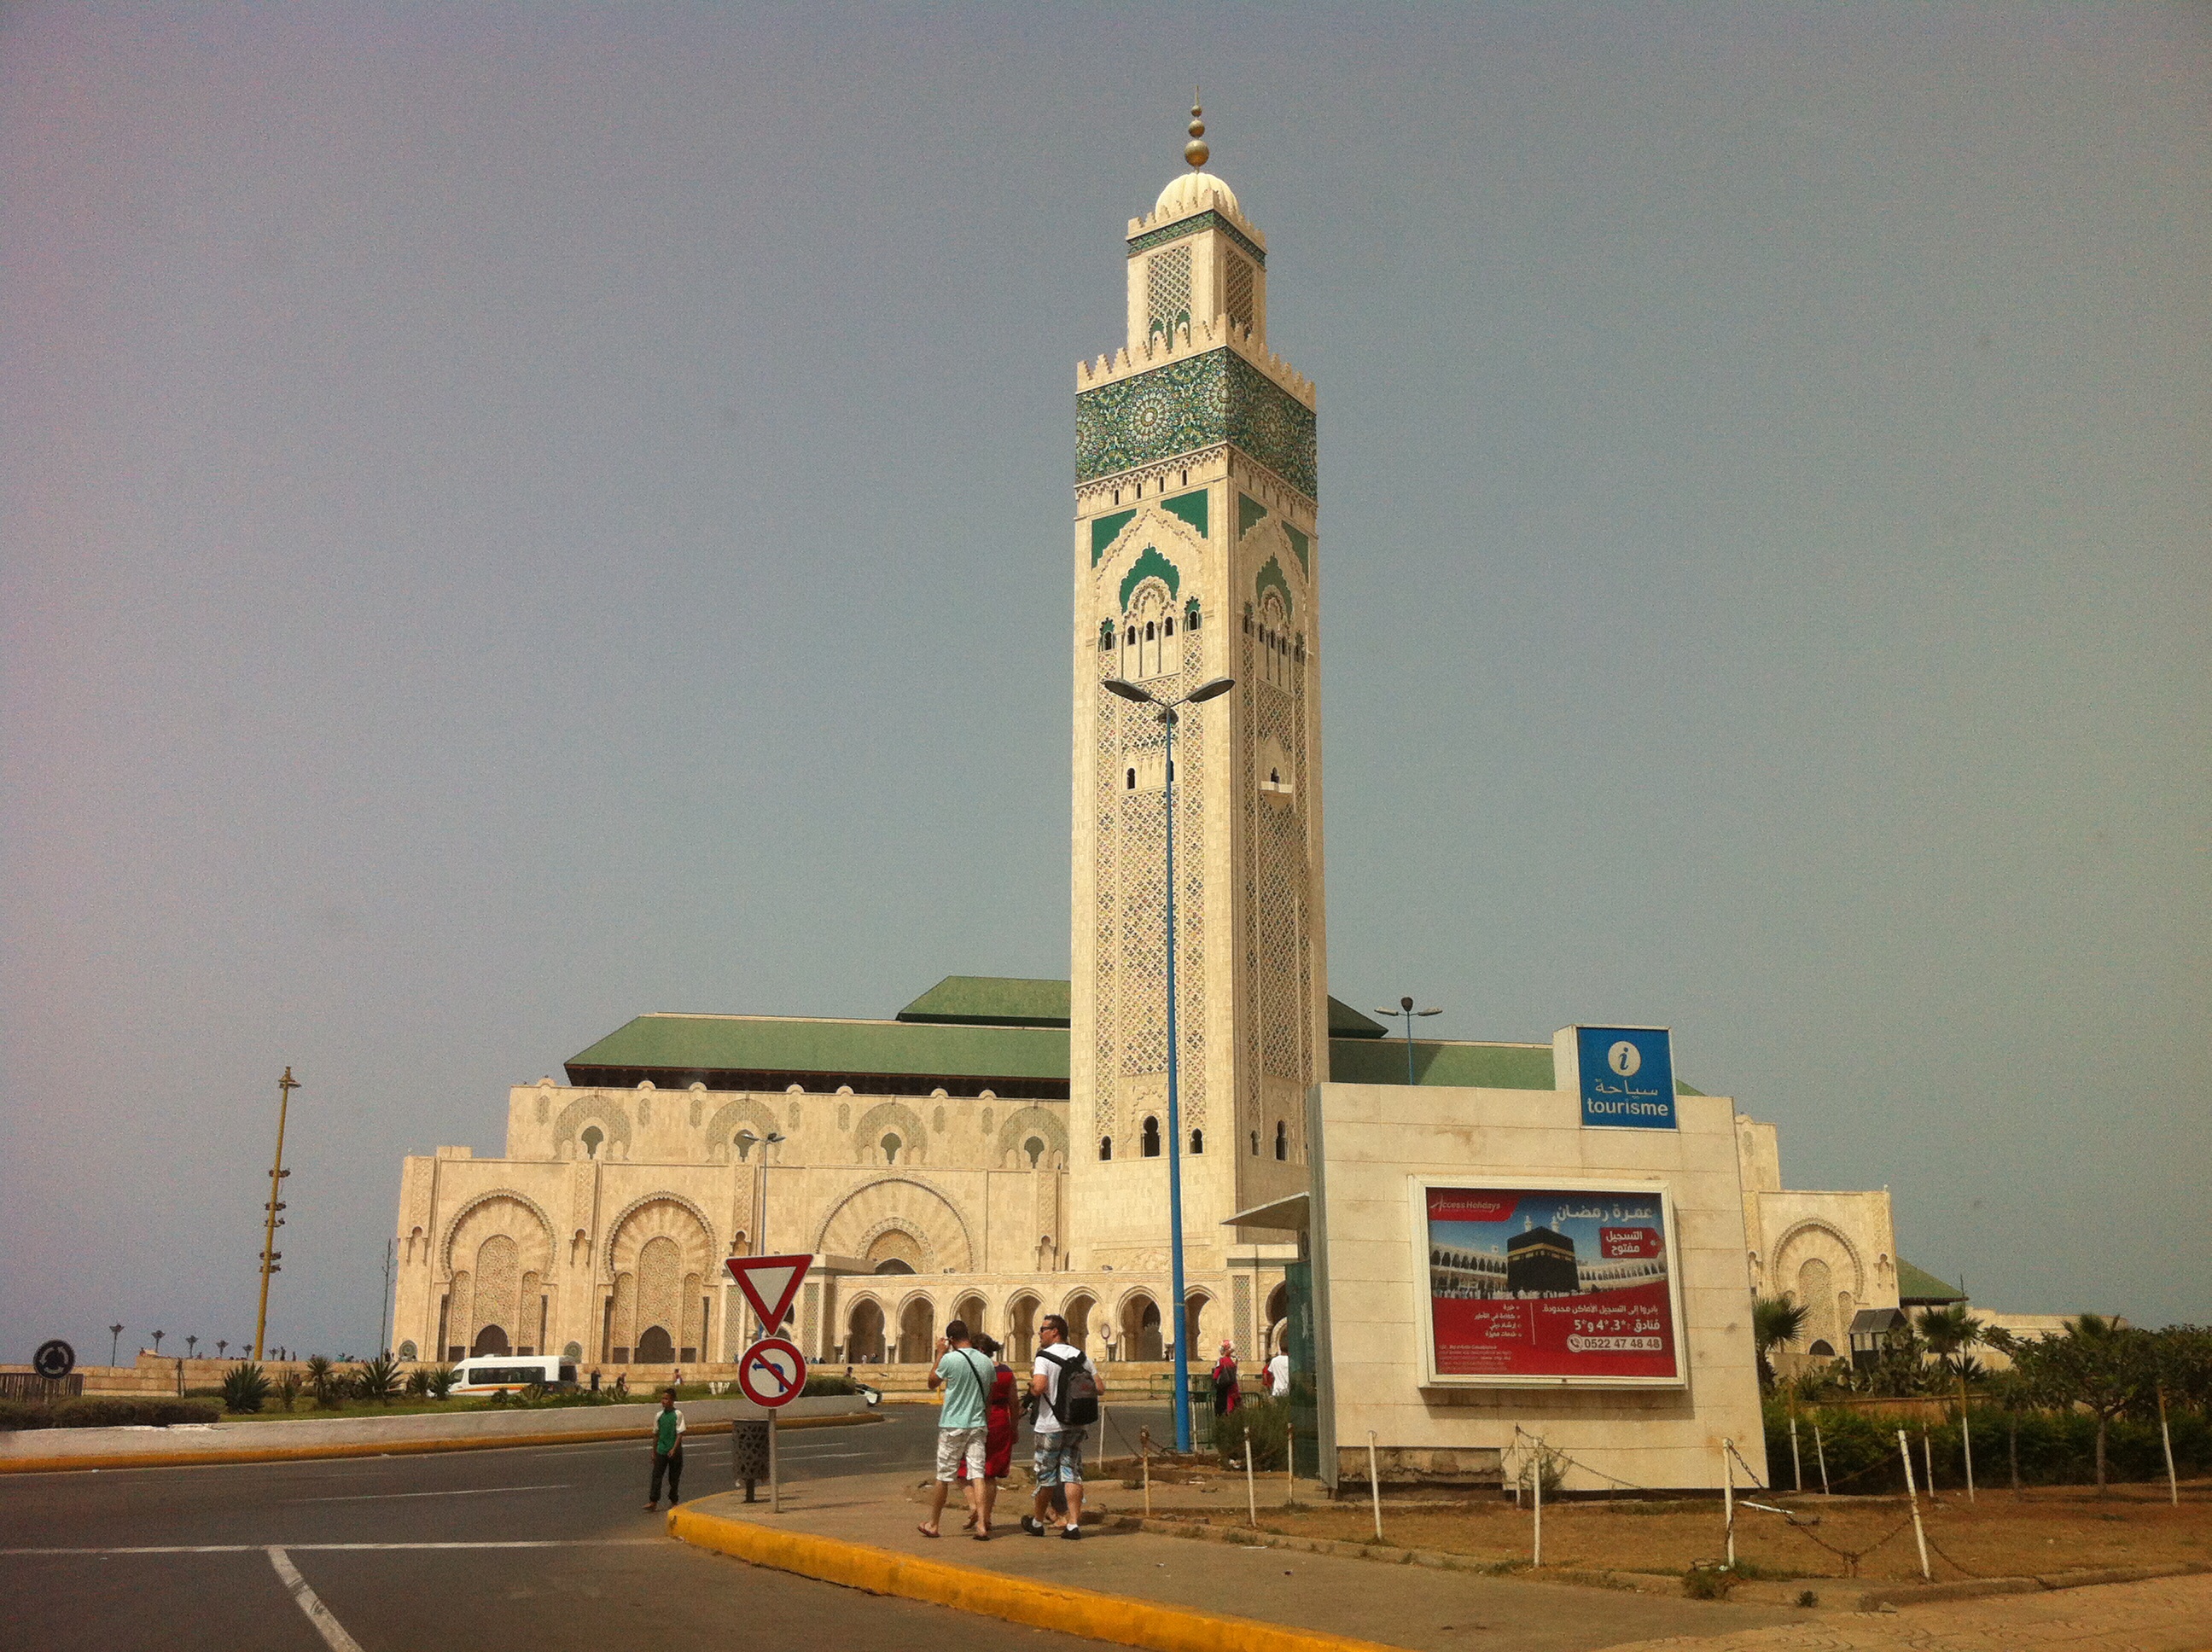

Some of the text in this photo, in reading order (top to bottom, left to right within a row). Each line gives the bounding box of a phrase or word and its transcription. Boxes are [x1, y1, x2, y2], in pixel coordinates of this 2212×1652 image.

[1594, 1078, 1658, 1100] سياحة
[1587, 1097, 1668, 1116] tourisme
[1557, 1203, 1652, 1222] عمرة رمضان
[1606, 1230, 1643, 1242] التسجيل
[1611, 1242, 1639, 1256] مفتوح
[1599, 1305, 1626, 1315] التسجيل
[1584, 1339, 1660, 1348] 0522 47 48 48
